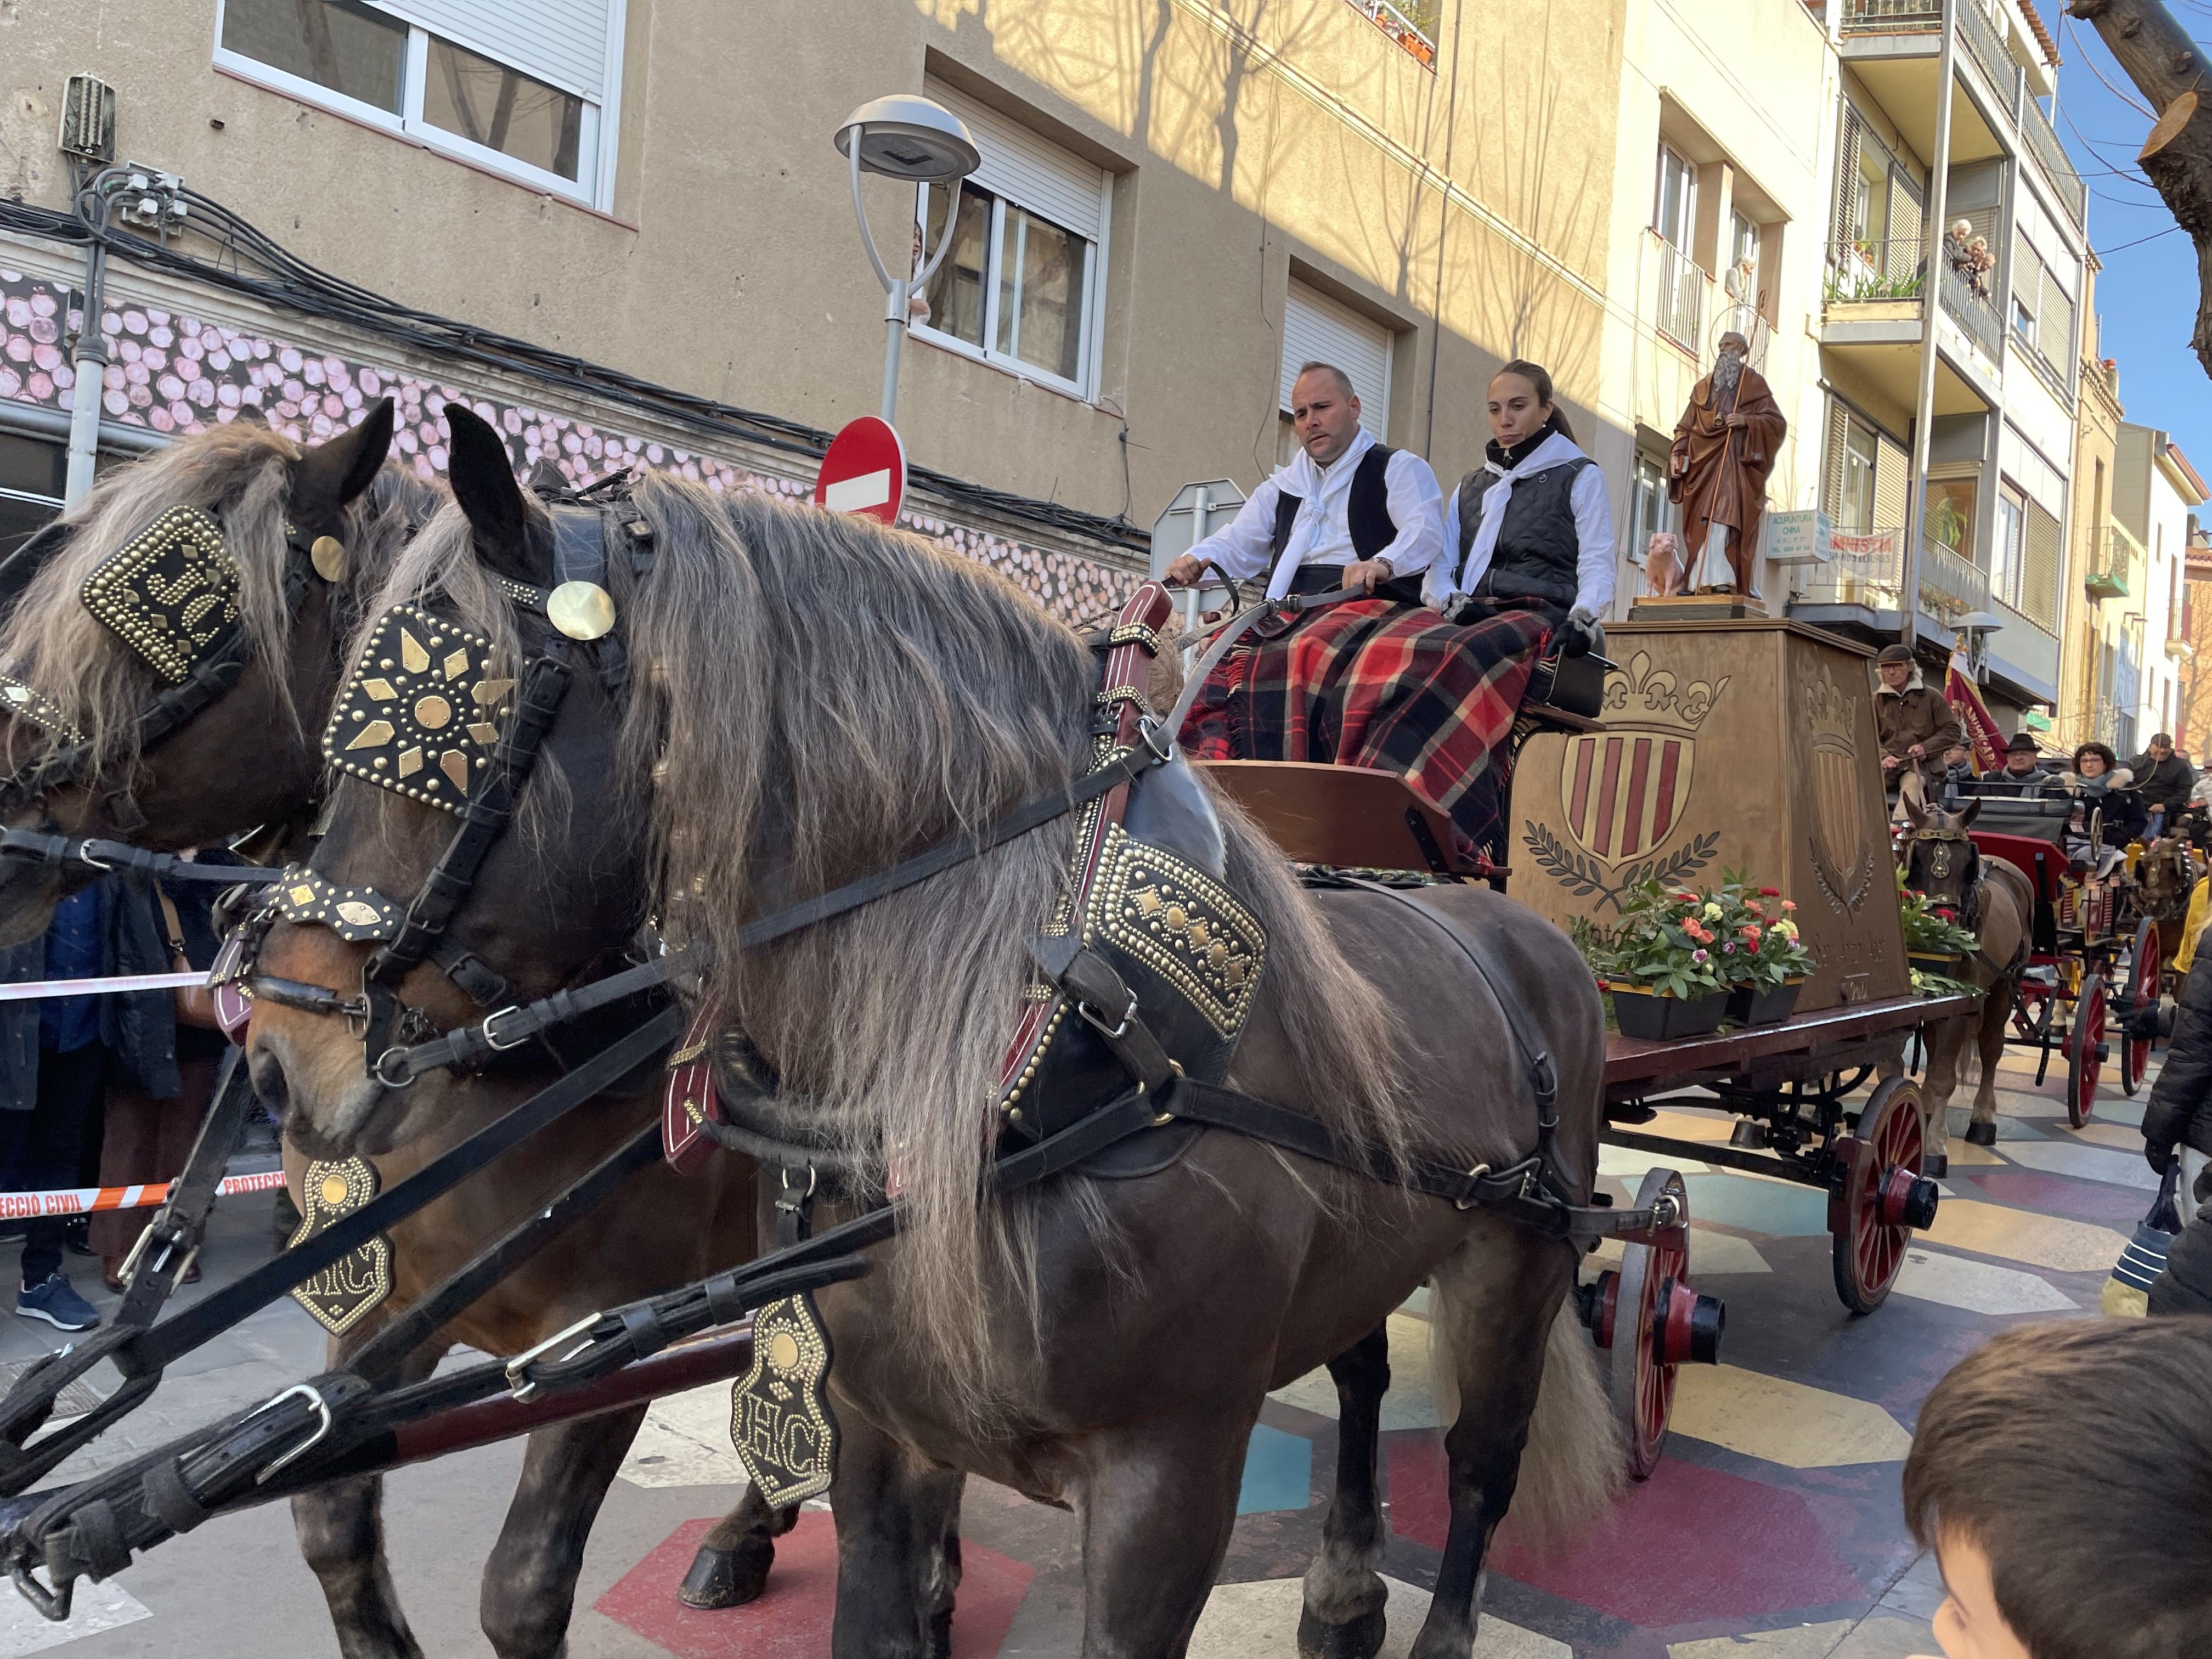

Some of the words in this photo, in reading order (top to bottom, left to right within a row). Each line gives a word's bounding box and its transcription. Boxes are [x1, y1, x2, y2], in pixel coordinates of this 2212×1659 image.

[1773, 515, 1812, 524] ACUPUNTURA
[1782, 526, 1801, 535] CHINA
[45, 1194, 82, 1215] CIVIL
